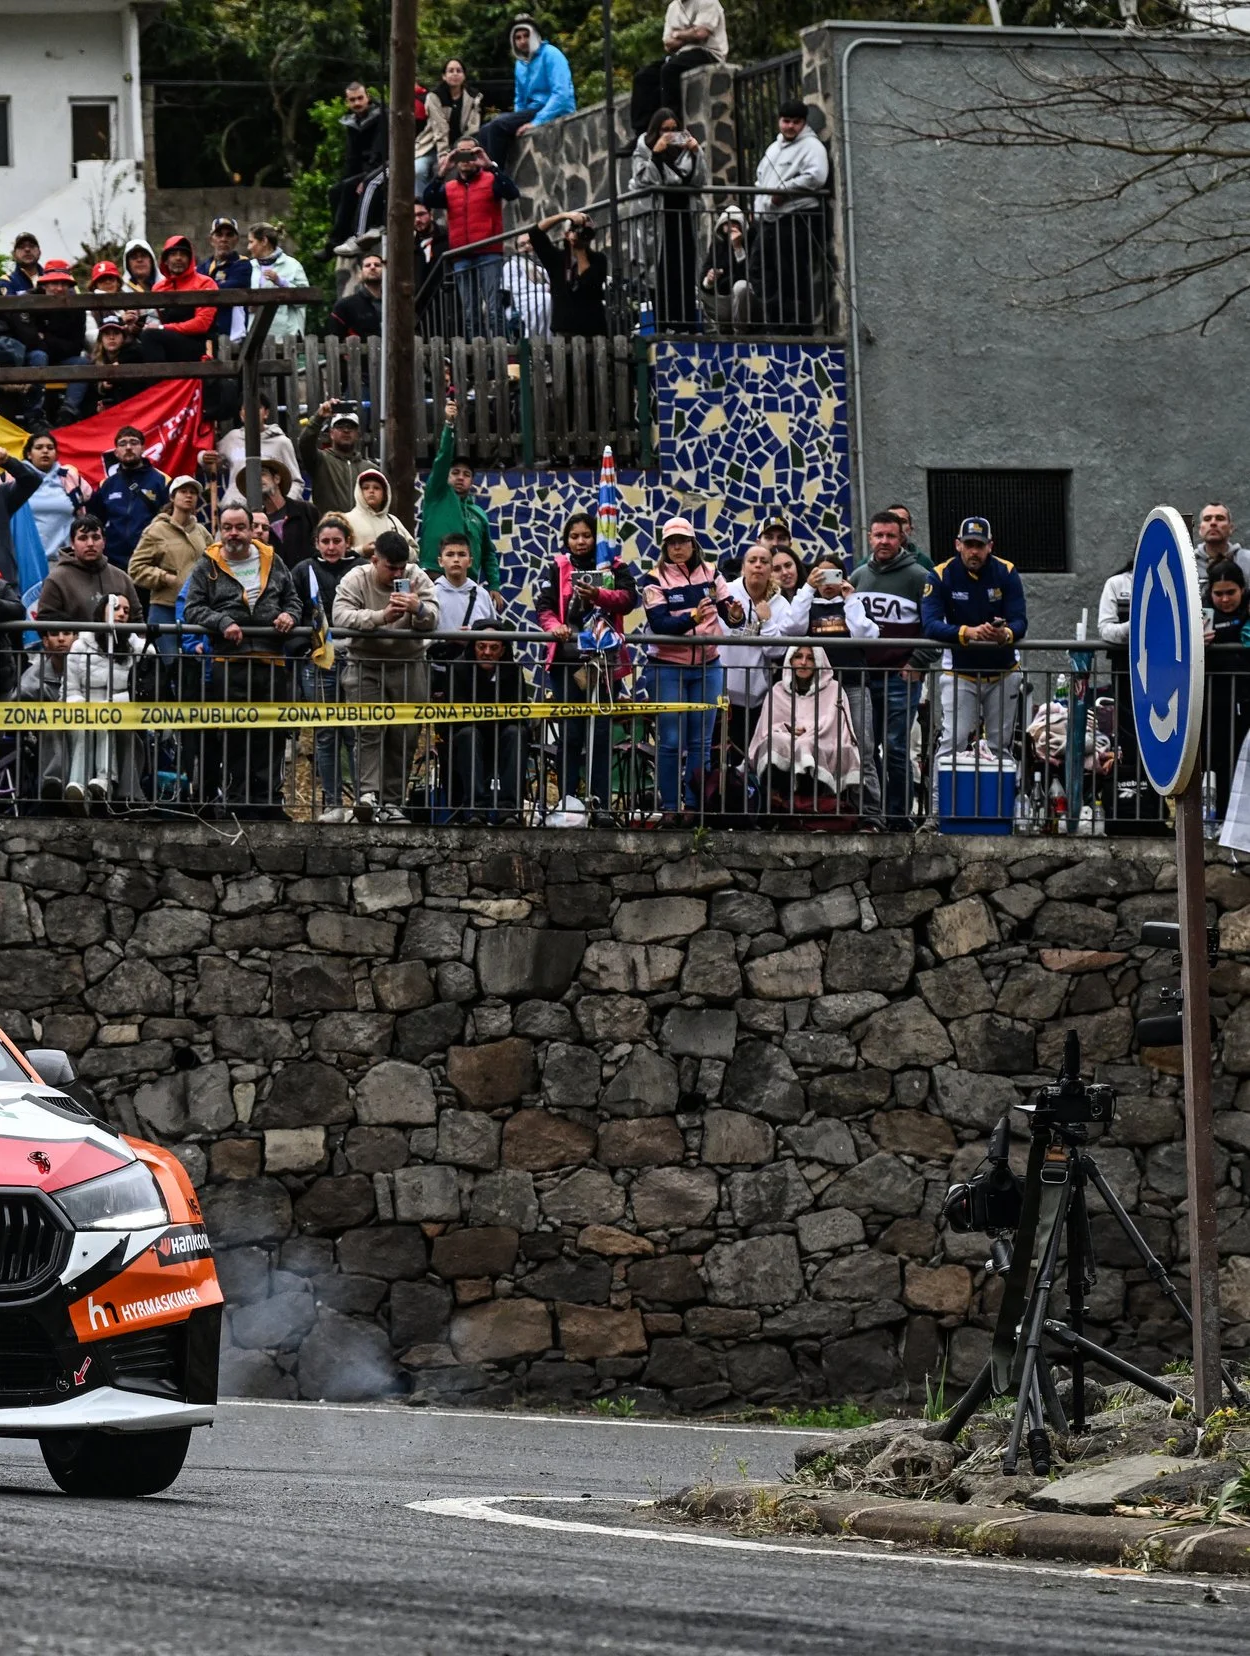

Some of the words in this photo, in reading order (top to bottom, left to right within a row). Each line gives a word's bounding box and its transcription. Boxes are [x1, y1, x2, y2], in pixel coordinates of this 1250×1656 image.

[857, 597, 902, 620] ASA
[4, 708, 48, 724] ZONA
[52, 708, 122, 724] PUBLICO
[141, 708, 185, 724] ZONA
[190, 707, 259, 724] PUBLICO
[278, 706, 322, 722] ZONA
[326, 706, 396, 721] PUBLICO
[414, 706, 458, 720] ZONA
[462, 704, 532, 719] PUBLICO
[550, 706, 594, 716] ZONA
[120, 1287, 202, 1322] HYRMASKINER
